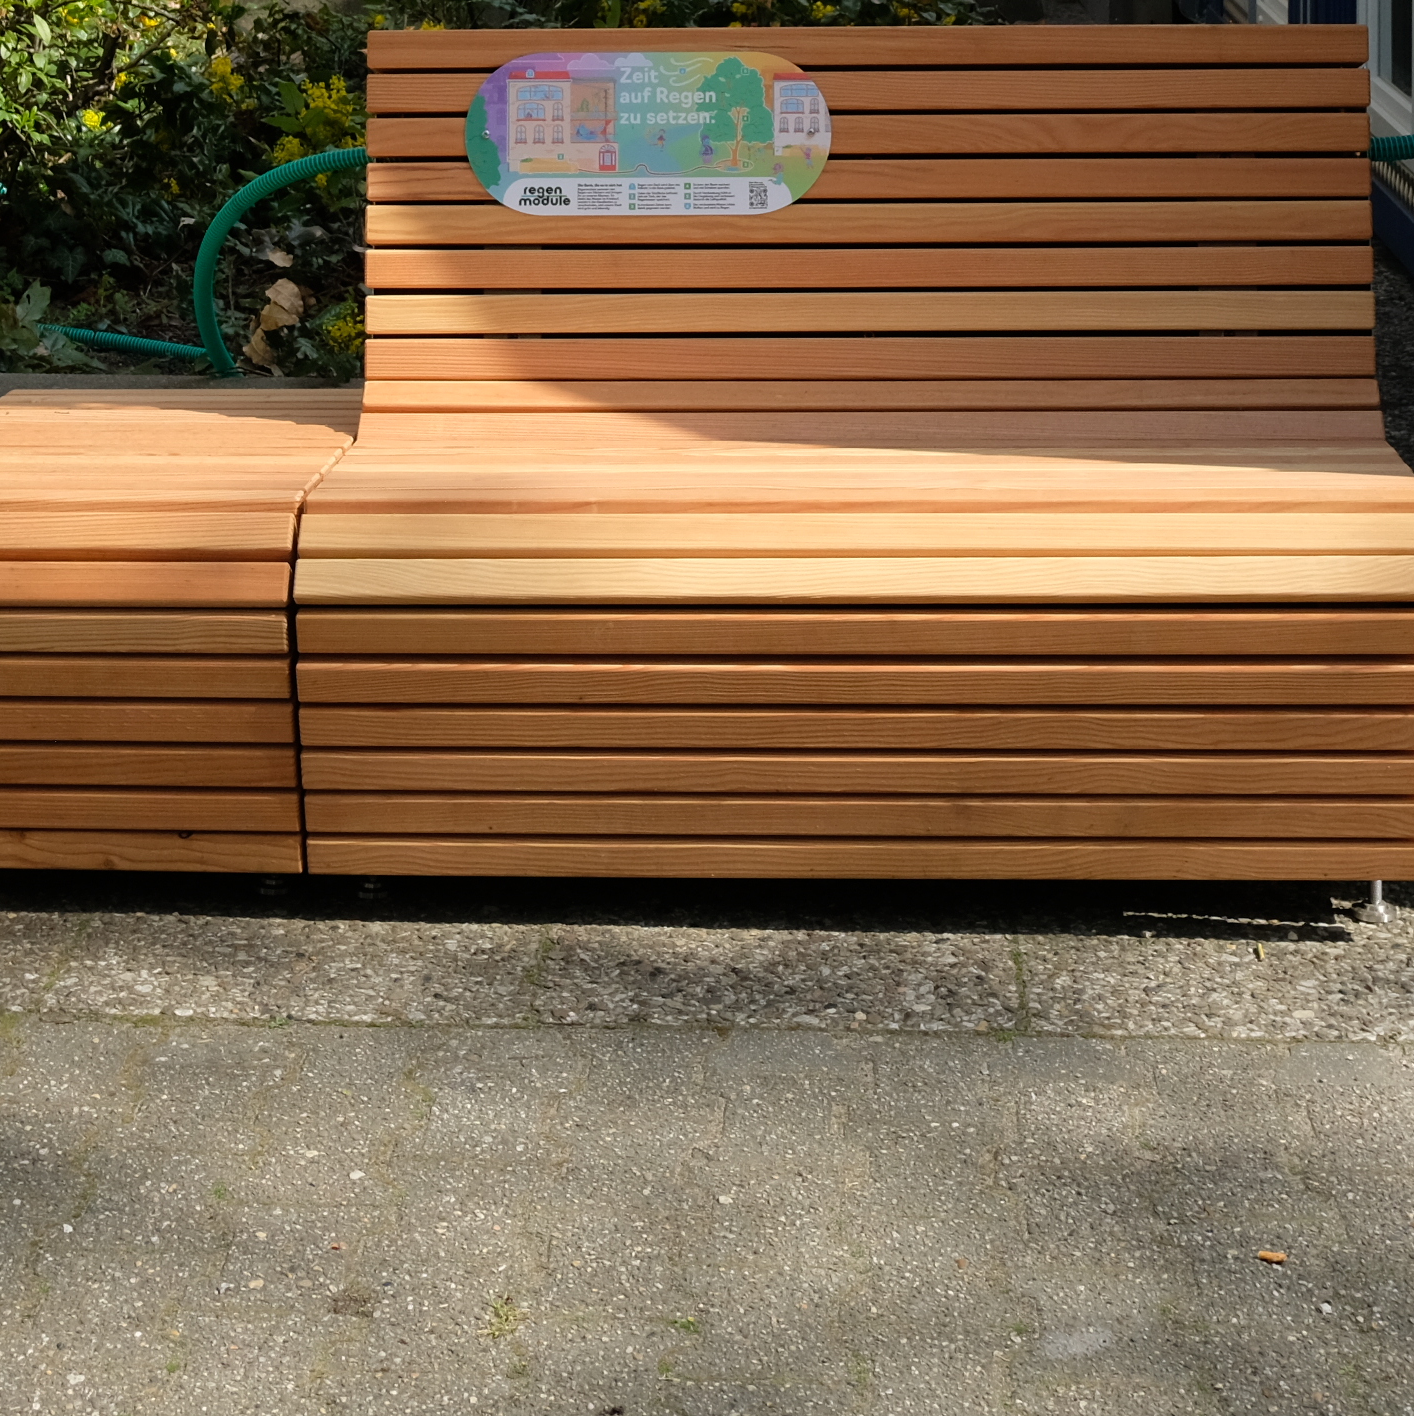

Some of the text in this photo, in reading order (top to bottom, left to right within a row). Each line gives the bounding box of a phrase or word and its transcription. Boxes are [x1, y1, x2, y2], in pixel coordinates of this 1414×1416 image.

[619, 67, 659, 84] Zeit
[619, 87, 717, 108] auf Regen
[619, 110, 716, 125] zu setzen.
[523, 186, 563, 198] regen
[518, 195, 571, 206] module
